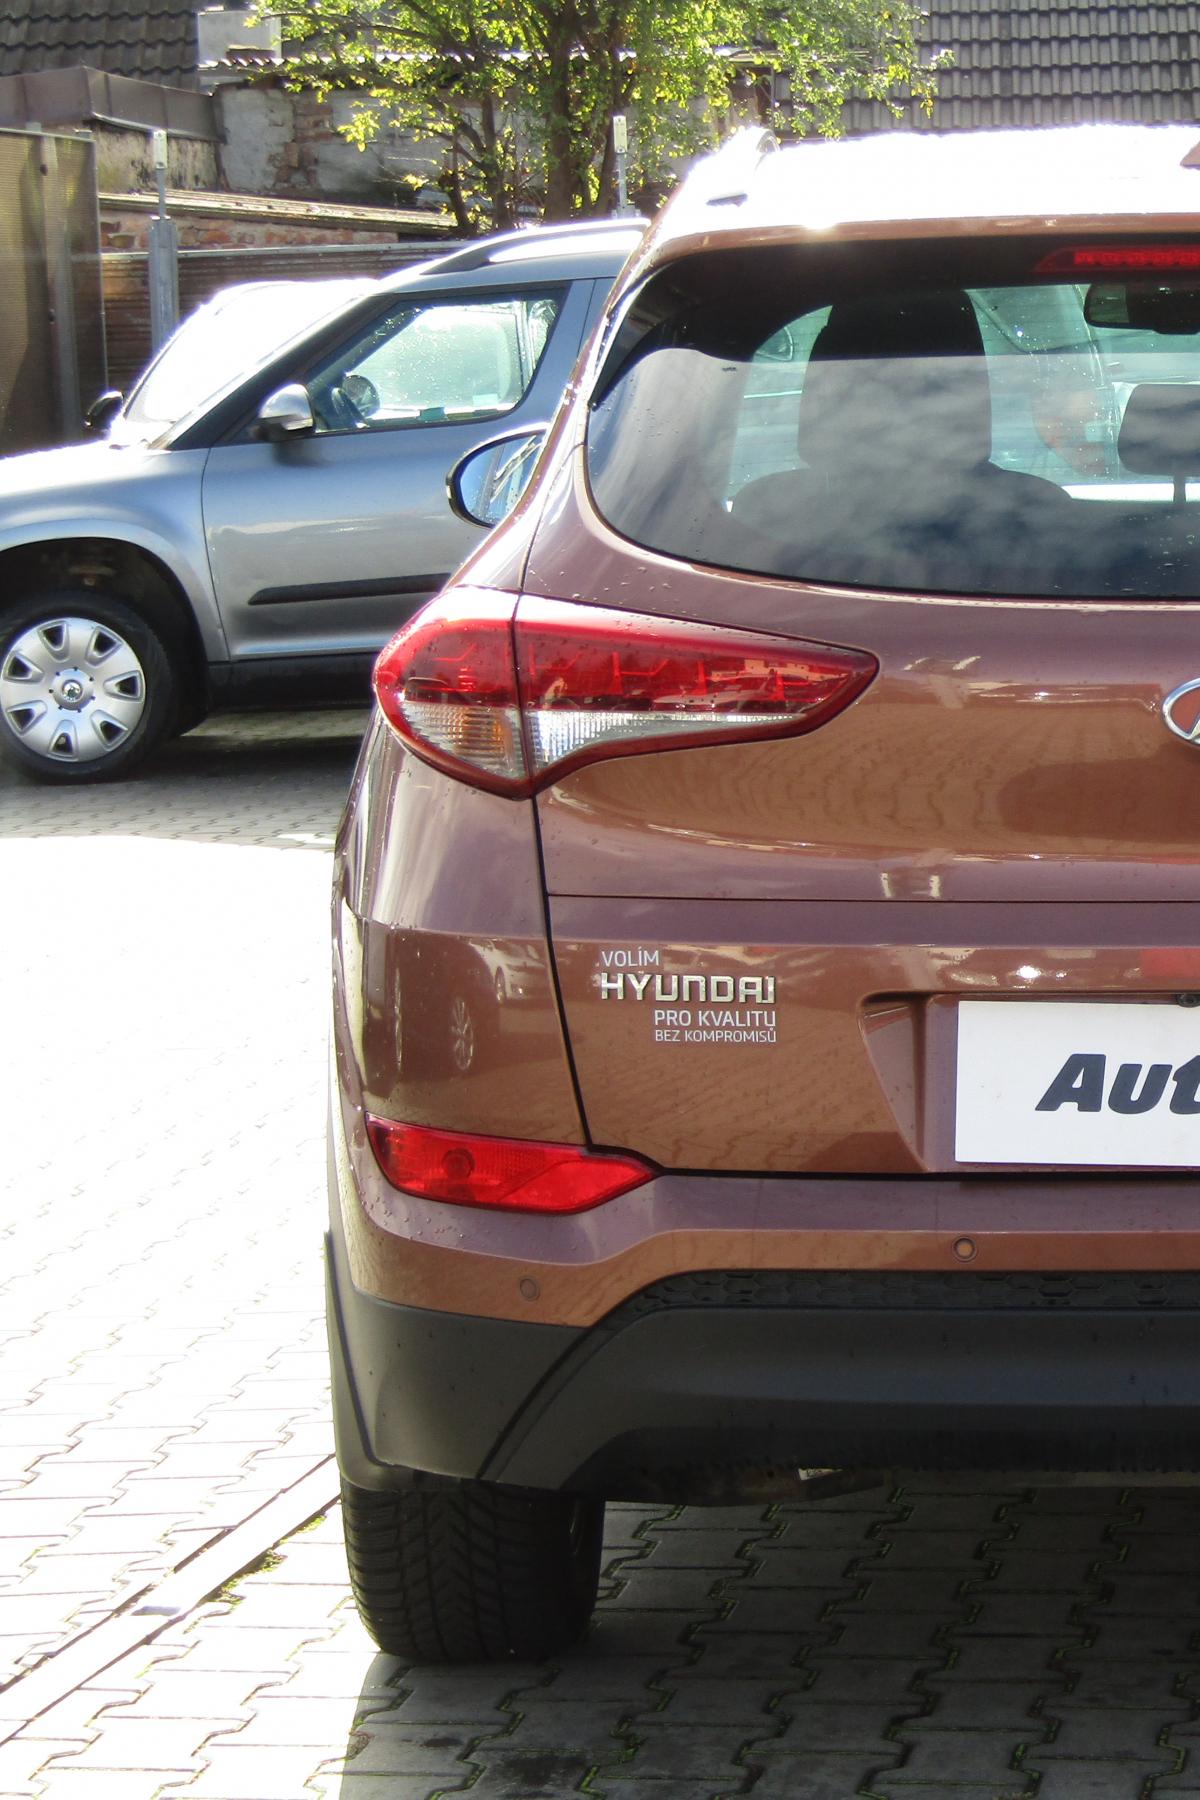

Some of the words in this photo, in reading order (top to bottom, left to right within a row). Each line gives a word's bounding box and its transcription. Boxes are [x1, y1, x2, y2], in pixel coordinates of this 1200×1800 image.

[601, 946, 660, 967] VOLÍM
[601, 972, 776, 1004] HYUNDAI
[654, 1009, 691, 1026] PRO
[698, 1010, 776, 1027] KVALITU
[655, 1030, 680, 1042] BEZ
[684, 1027, 777, 1043] KOMPROMISŮ
